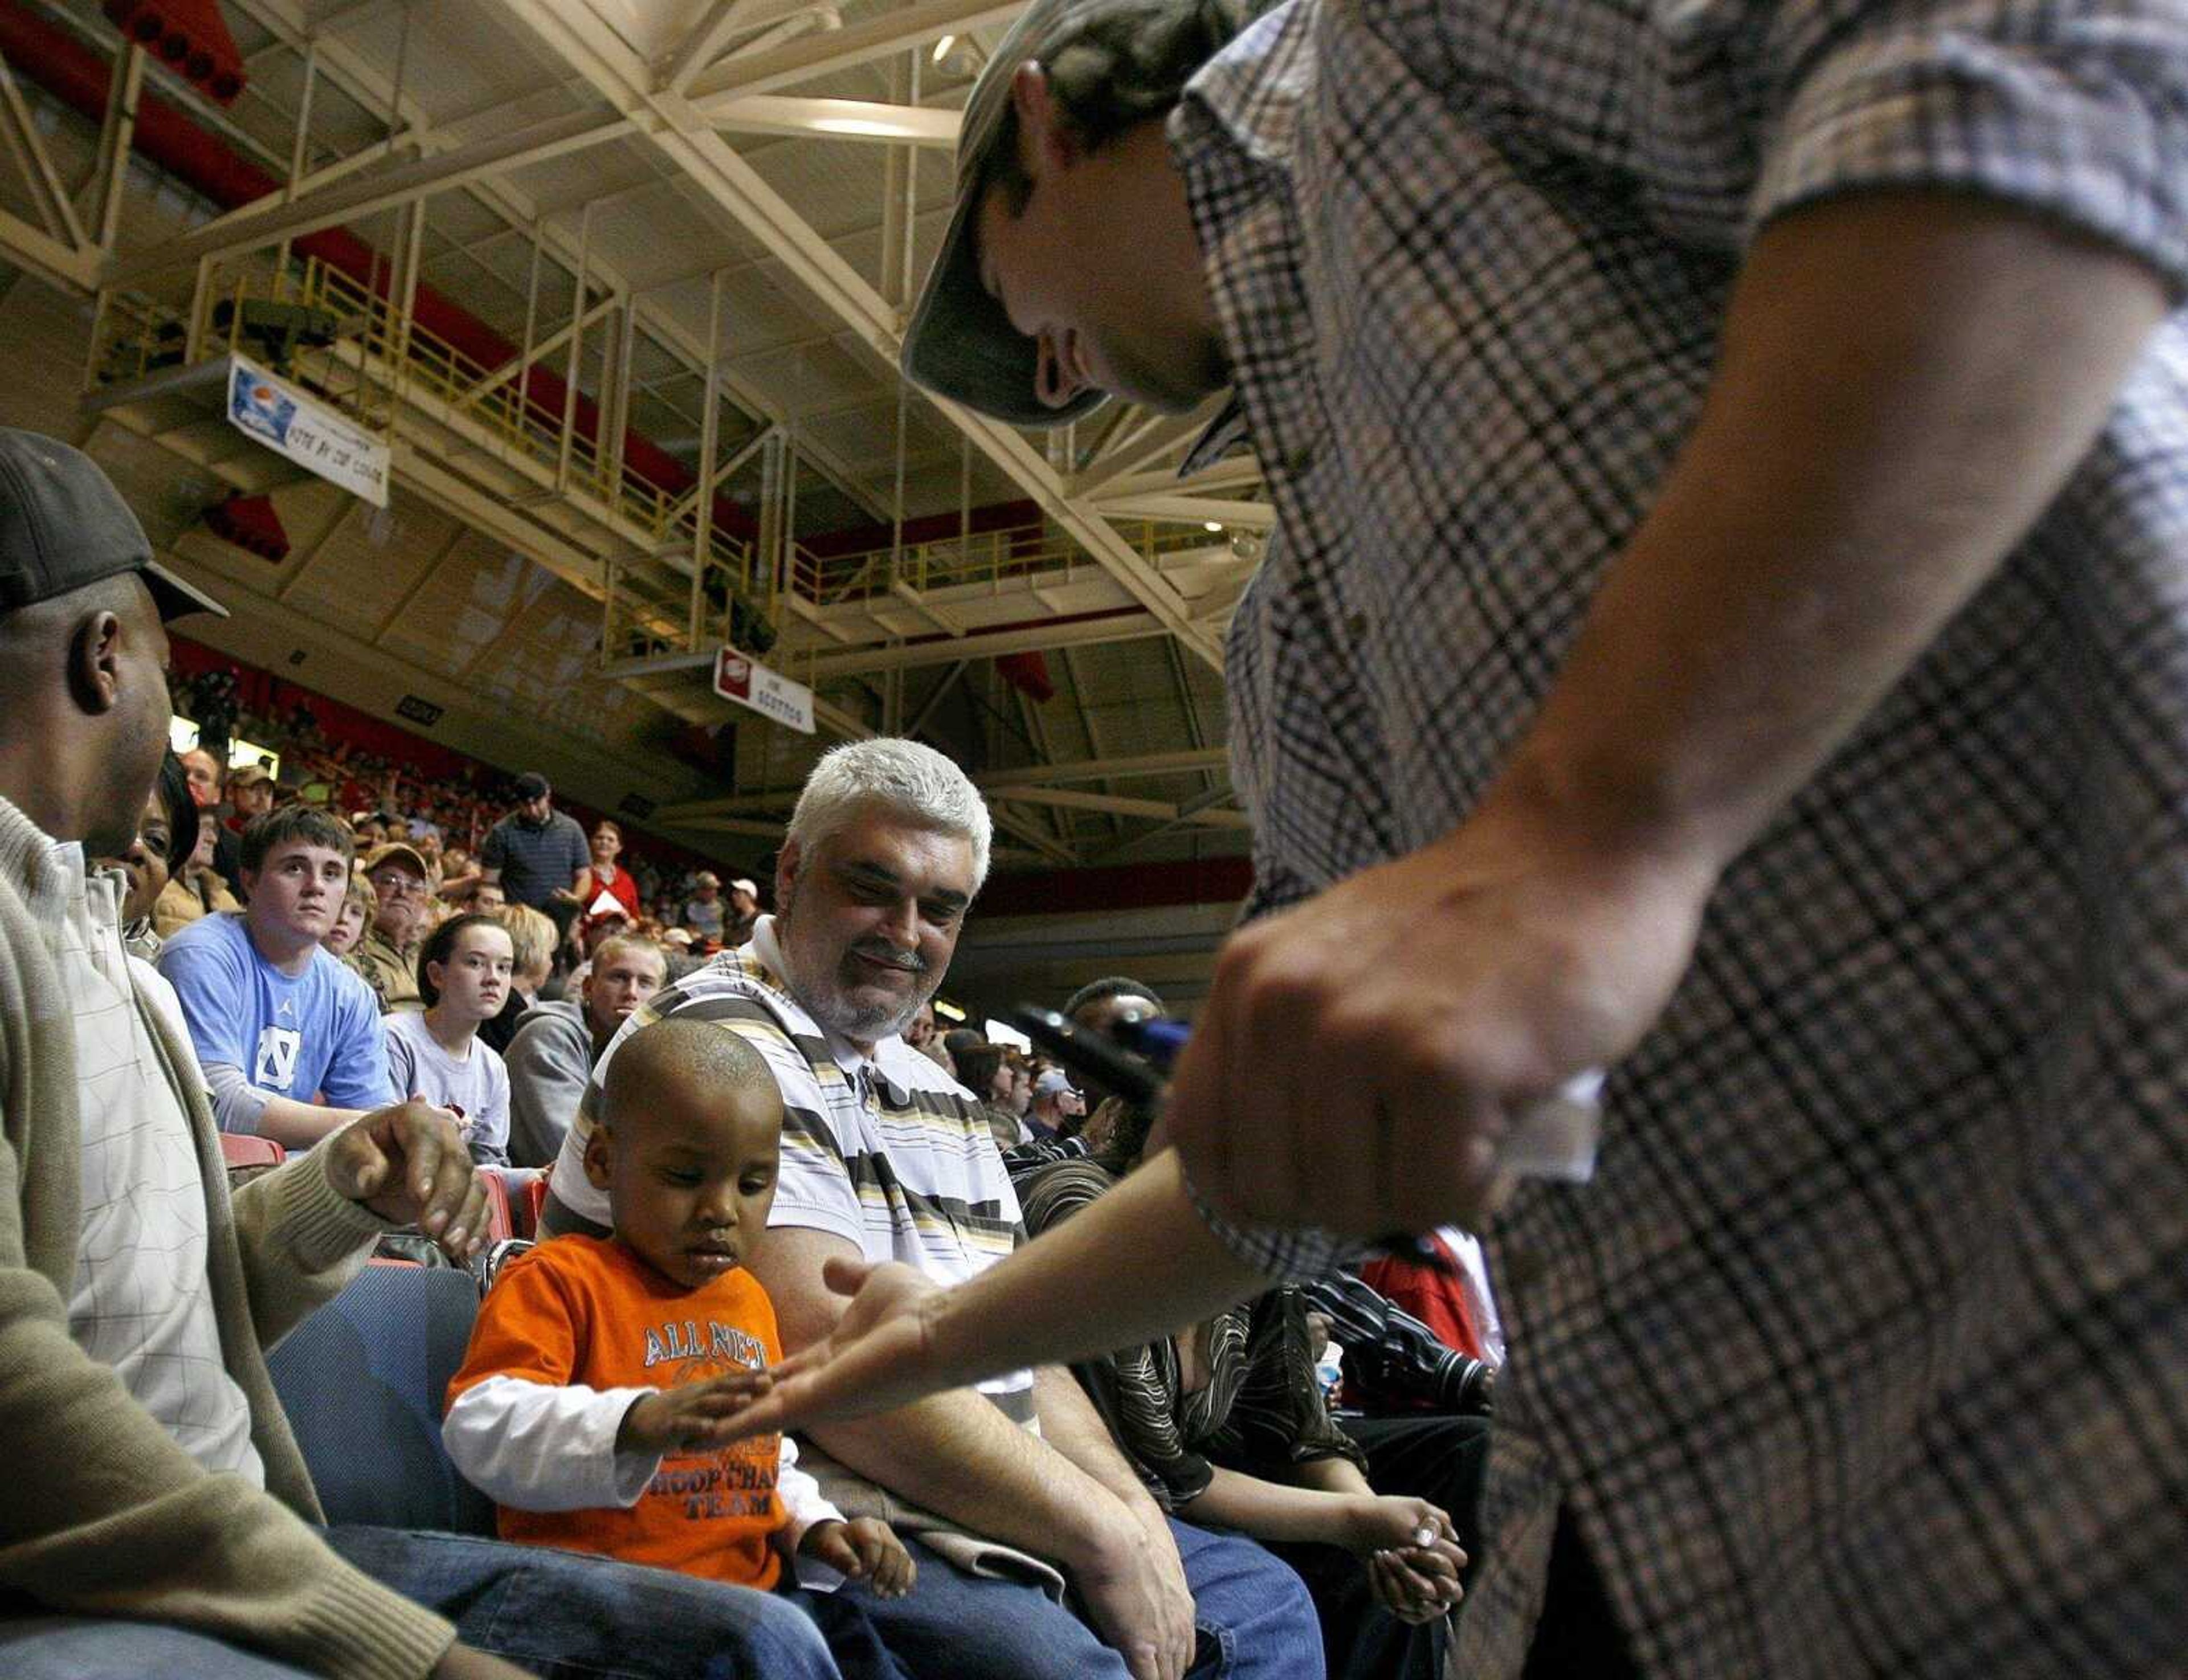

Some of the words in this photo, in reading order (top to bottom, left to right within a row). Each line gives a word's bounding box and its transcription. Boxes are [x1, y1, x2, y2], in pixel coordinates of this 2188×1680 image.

[644, 1322, 706, 1368] ALL
[707, 1322, 766, 1370] NET
[685, 1491, 770, 1520] TEAM
